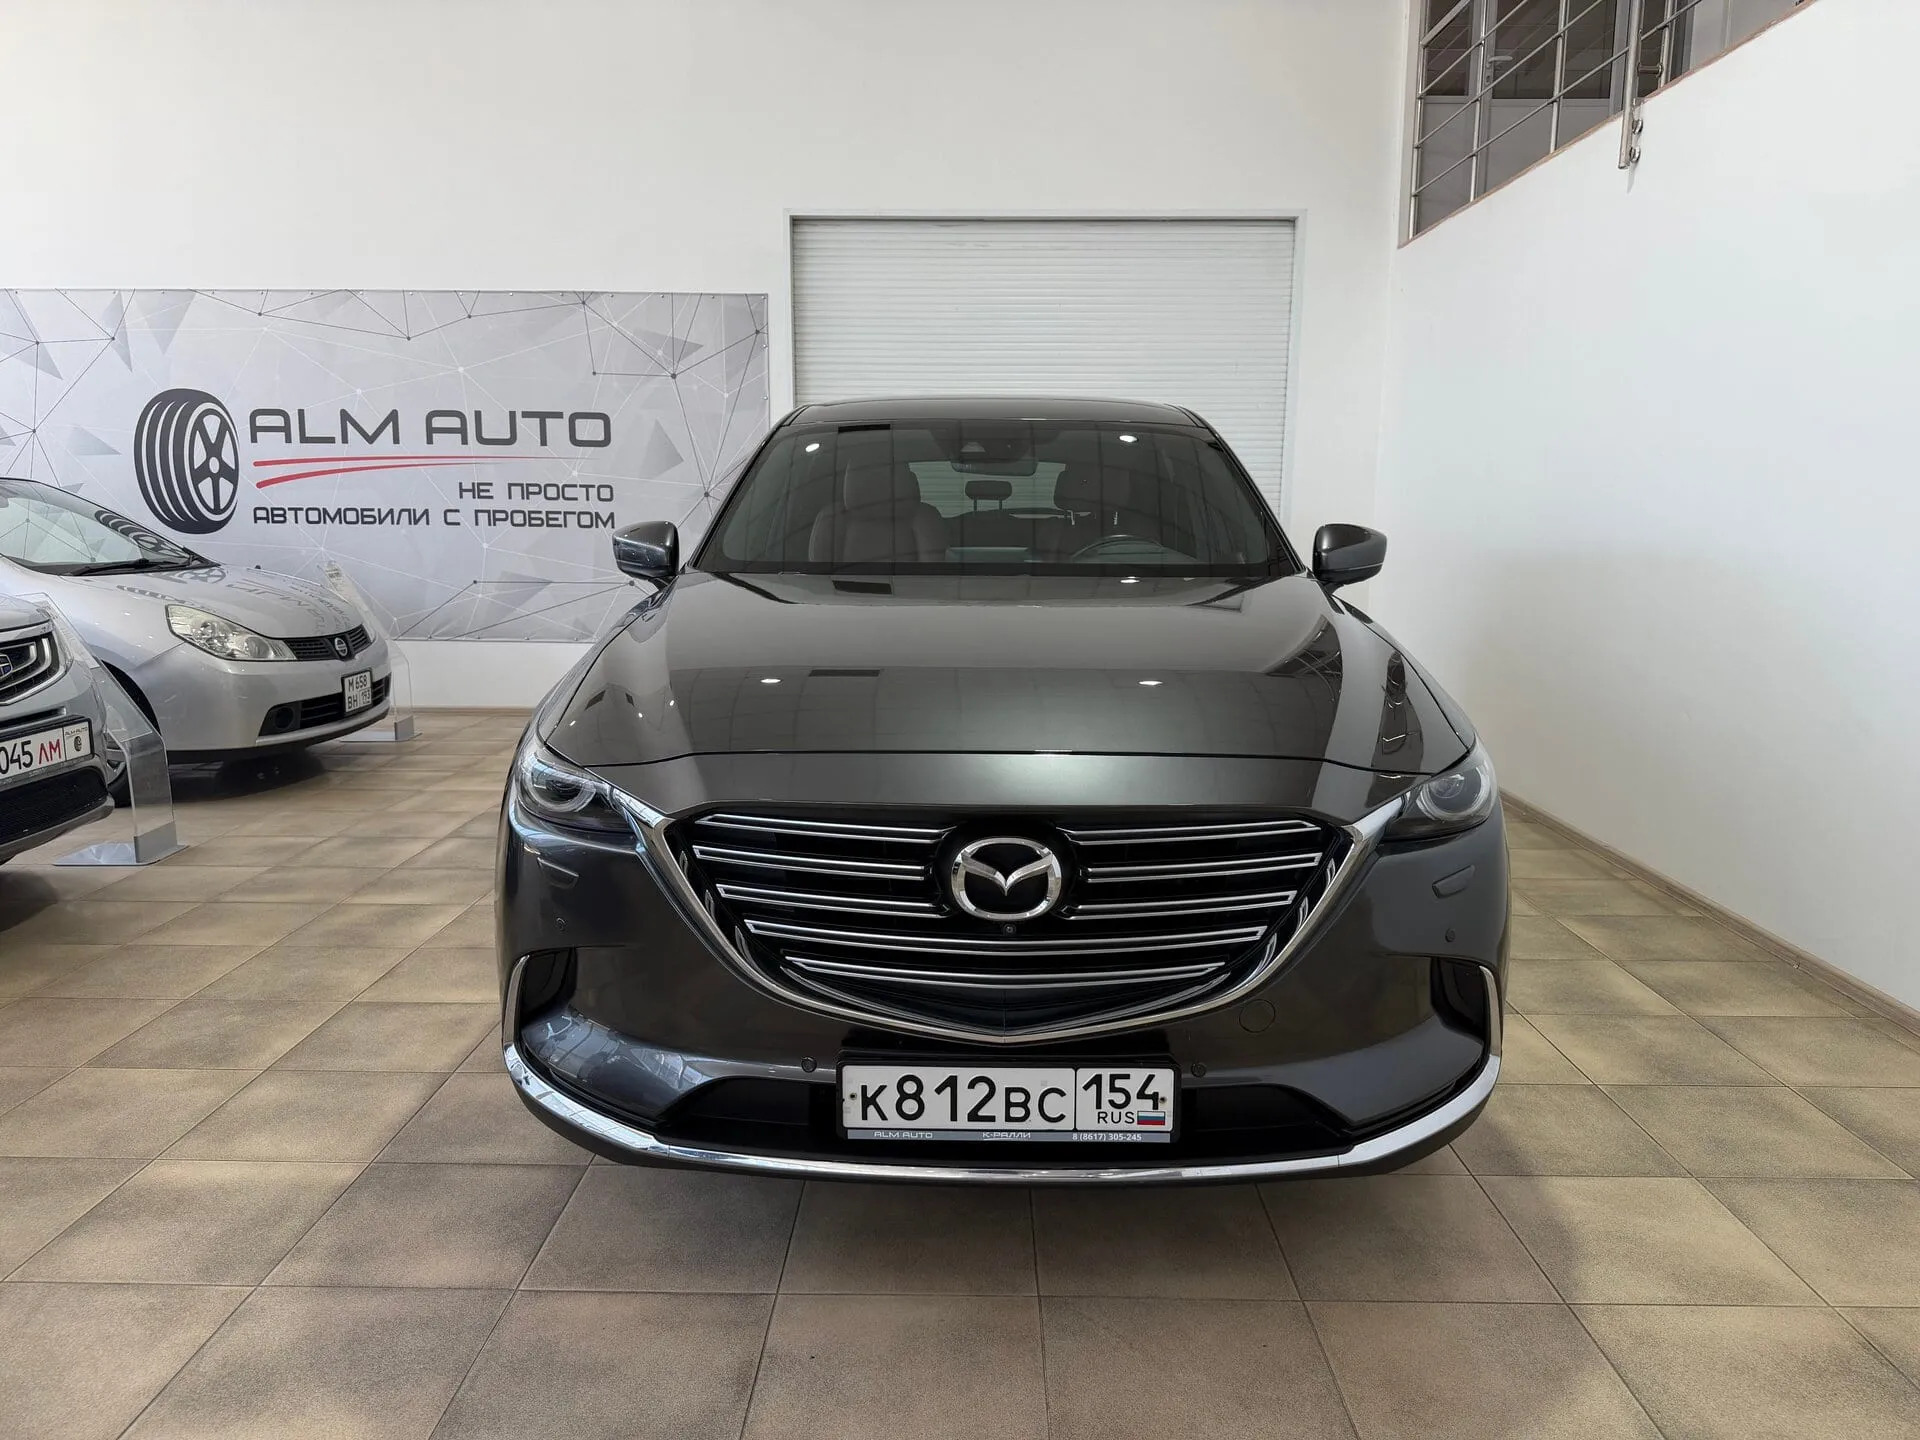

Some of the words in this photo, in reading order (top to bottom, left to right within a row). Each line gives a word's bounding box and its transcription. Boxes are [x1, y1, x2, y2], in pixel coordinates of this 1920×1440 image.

[250, 408, 400, 445] ALM
[425, 409, 611, 448] AUTO
[459, 482, 494, 499] НЕ
[508, 483, 614, 502] ПРОСТО
[253, 506, 430, 526] АВТОМОБИЛИ
[474, 510, 615, 529] ПРОБЕГОМ
[1082, 1074, 1160, 1110] 154
[1097, 1111, 1135, 1124] RUS
[902, 1131, 933, 1139] AUTO
